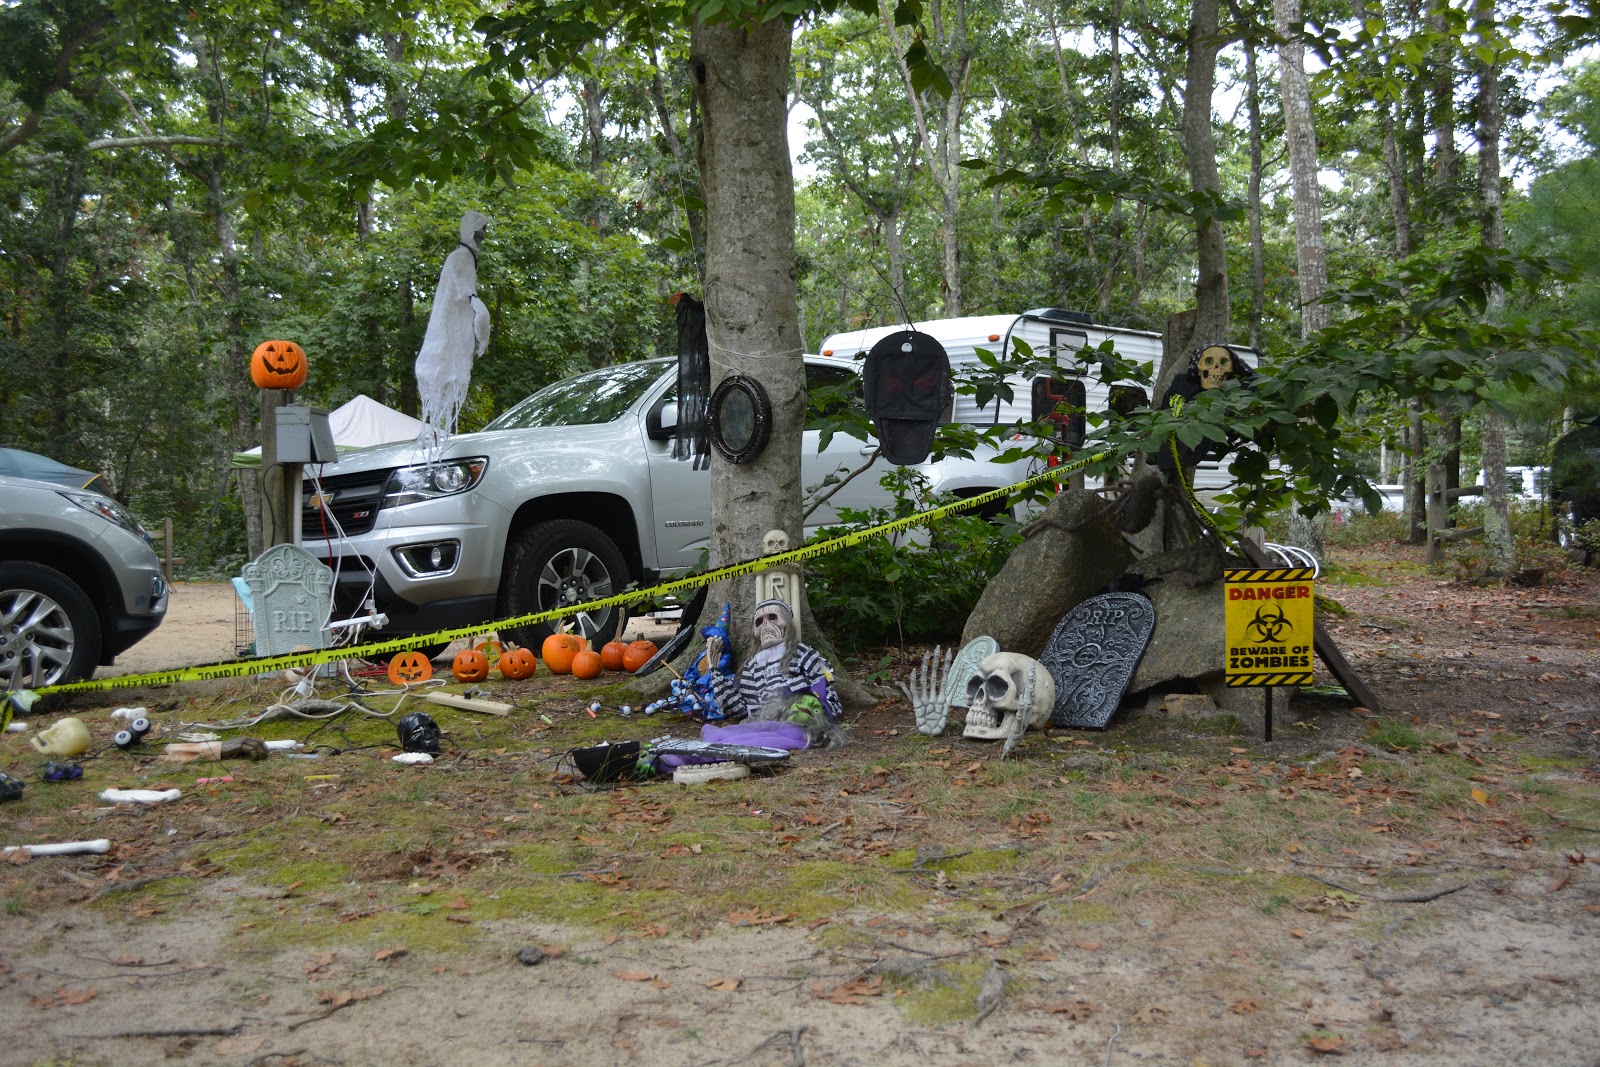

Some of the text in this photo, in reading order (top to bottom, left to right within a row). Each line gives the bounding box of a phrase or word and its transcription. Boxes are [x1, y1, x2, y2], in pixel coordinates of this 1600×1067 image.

[665, 519, 704, 527] COLORADO
[1229, 586, 1310, 600] DANGER
[272, 610, 314, 633] RIP
[1086, 609, 1125, 625] RIP
[1230, 646, 1309, 656] BEWARE OF
[1230, 656, 1309, 669] ZOMBIES
